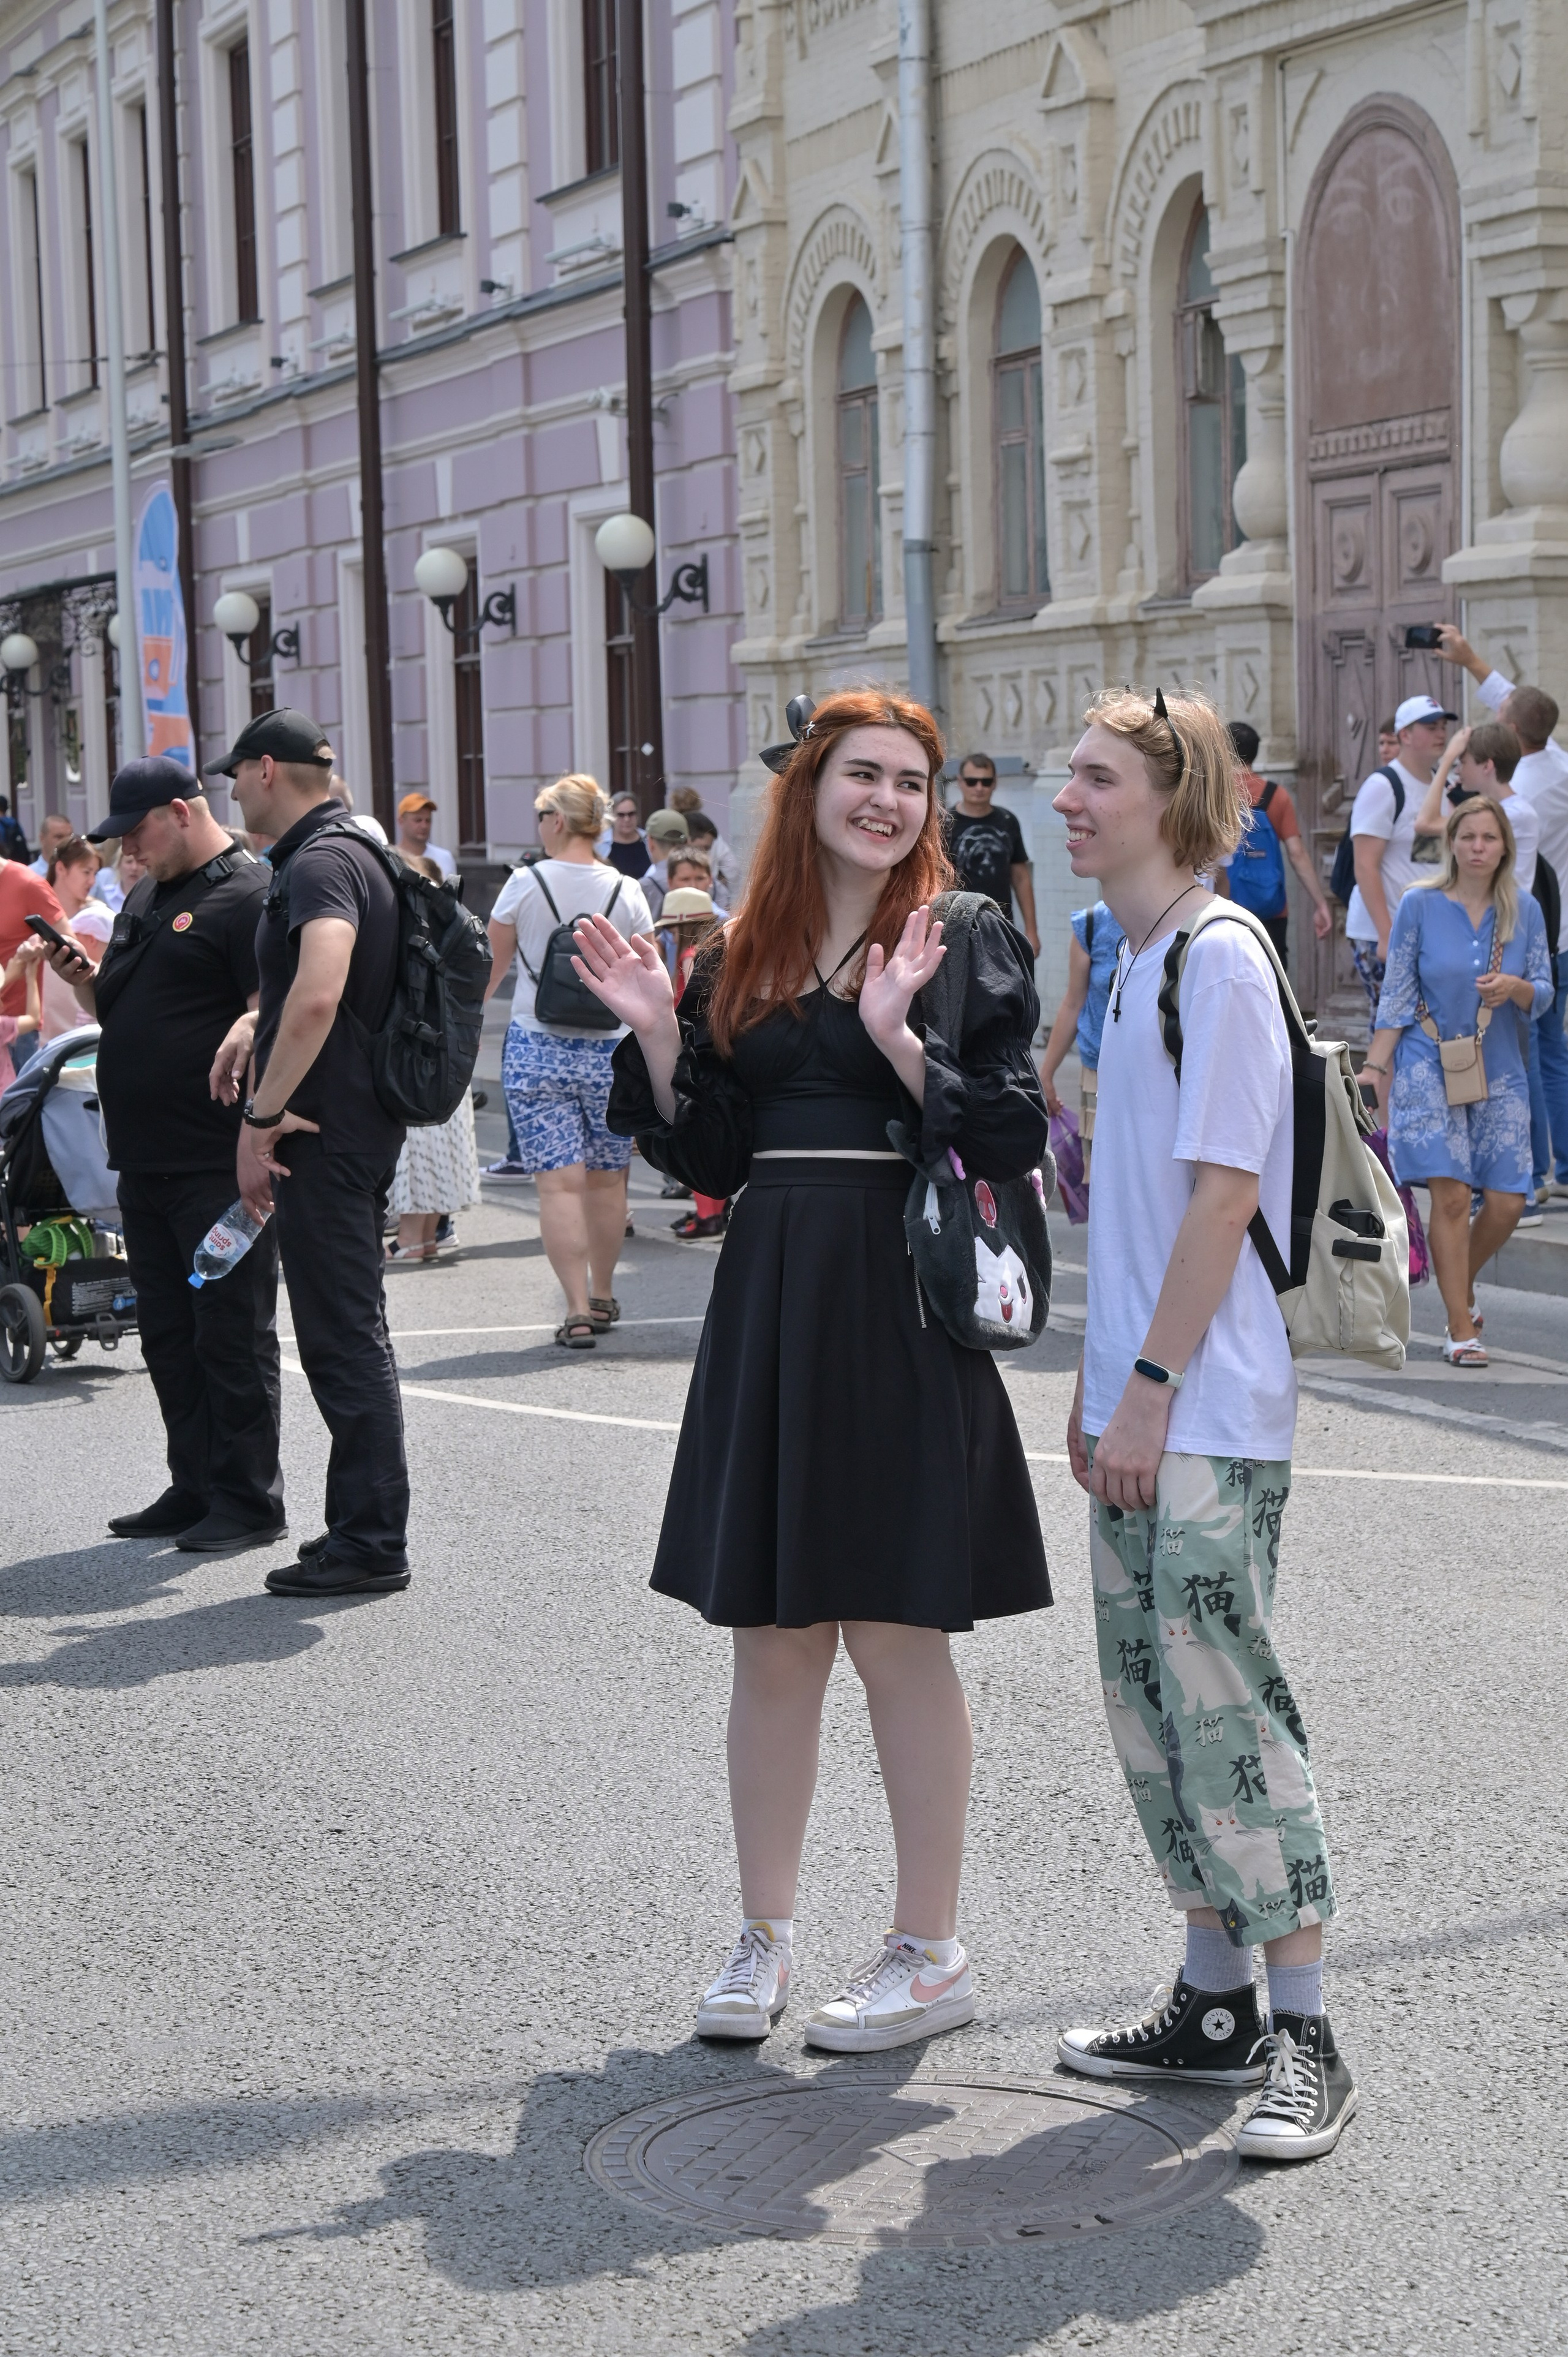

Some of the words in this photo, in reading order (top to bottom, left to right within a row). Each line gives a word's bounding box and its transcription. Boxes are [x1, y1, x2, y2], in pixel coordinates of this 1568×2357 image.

[209, 1234, 225, 1251] saint
[212, 1226, 232, 1247] spring
[1159, 1526, 1186, 1556] 猫
[1181, 1571, 1235, 1623] 猫
[1116, 1639, 1152, 1685] 猫
[1195, 1714, 1224, 1748] 猫
[1128, 1777, 1152, 1804] 猫
[1287, 1854, 1328, 1909] 猫
[902, 1942, 917, 1955] NIKE
[724, 2088, 909, 2118] МОСВОДОПРОМ
